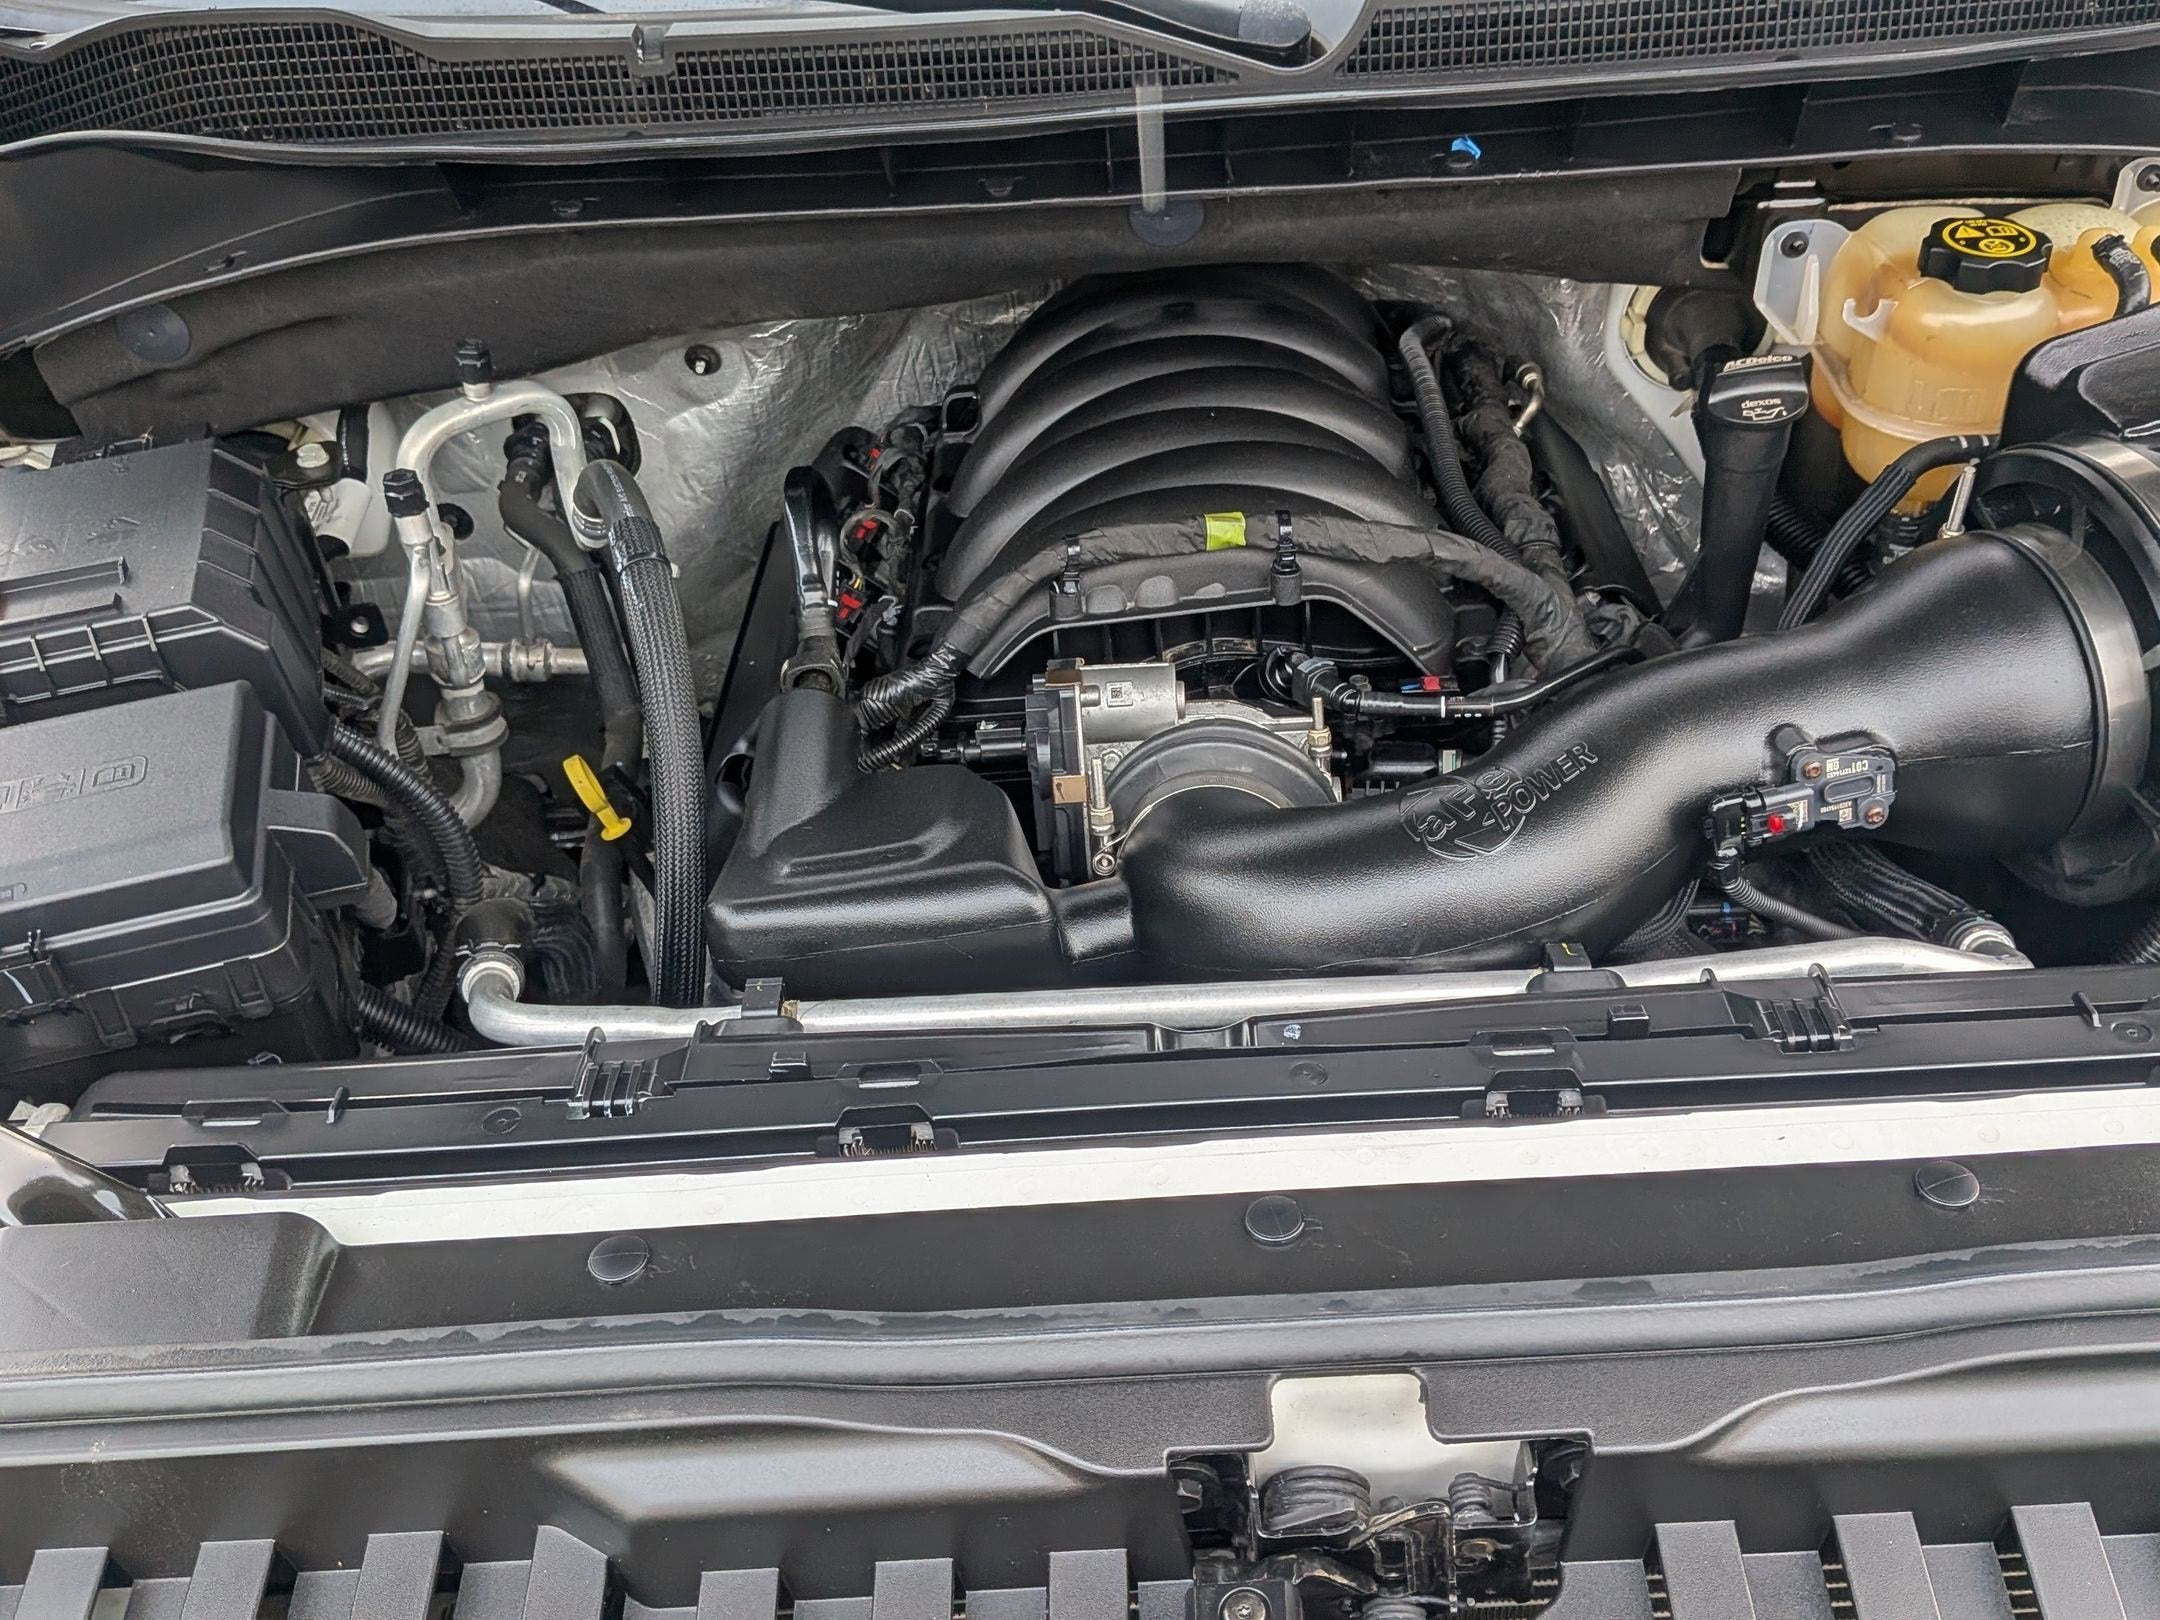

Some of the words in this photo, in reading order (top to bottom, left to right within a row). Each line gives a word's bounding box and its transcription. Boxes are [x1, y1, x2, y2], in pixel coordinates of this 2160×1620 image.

[1723, 355, 1793, 373] ACDelco
[1741, 398, 1781, 409] dexos
[1418, 768, 1511, 841] aFe
[1491, 741, 1598, 831] POWER
